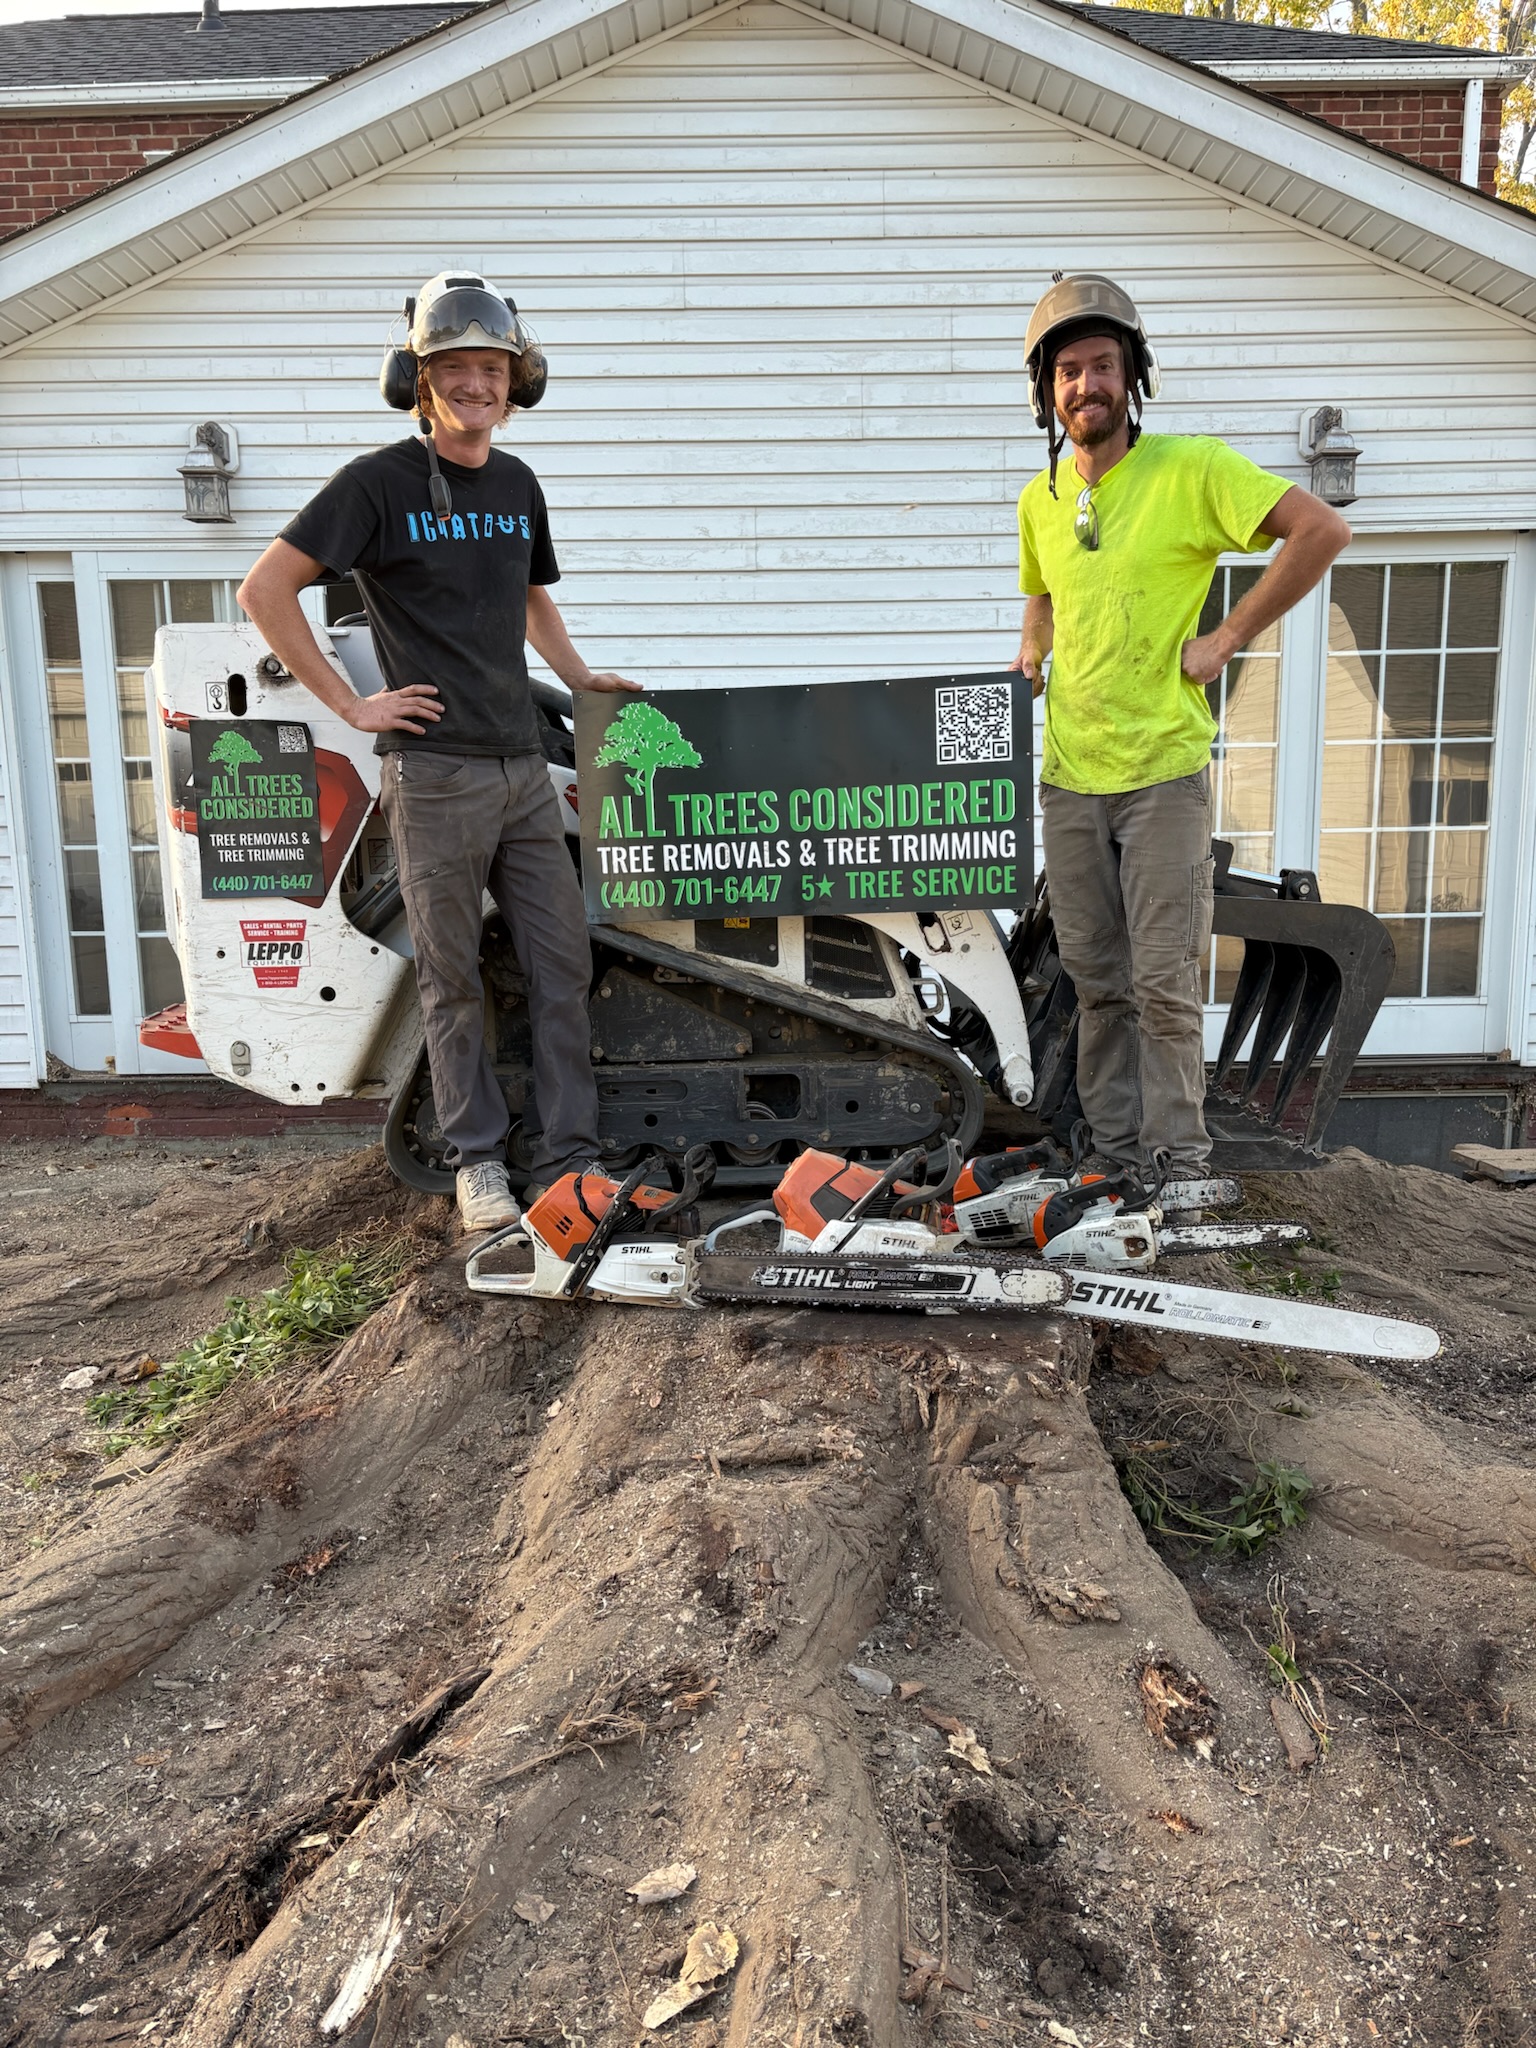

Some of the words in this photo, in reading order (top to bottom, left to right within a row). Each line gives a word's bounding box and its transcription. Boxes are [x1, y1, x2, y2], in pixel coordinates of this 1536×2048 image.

[211, 775, 245, 797] ALL
[245, 774, 303, 796] TREES
[200, 796, 314, 821] CONSIDERED
[599, 796, 667, 839] ALL
[668, 790, 780, 837] TREES
[789, 778, 1016, 833] CONSIDERED
[209, 833, 236, 847] TREE
[240, 832, 299, 846] REMOVALS
[301, 831, 311, 845] &
[218, 849, 245, 863] TREE
[247, 847, 305, 862] TRIMMING
[597, 845, 655, 875] TREE
[662, 839, 791, 872] REMOVALS
[799, 838, 817, 867] &
[823, 836, 882, 866] TREE
[888, 829, 1017, 863] TRIMMING
[212, 876, 249, 892] (440)
[251, 874, 313, 890] 701-6447
[600, 879, 666, 909] (440)
[671, 874, 782, 906] 701-6447
[845, 870, 904, 899] TREE
[912, 865, 1018, 897] SERVICE
[243, 922, 259, 930] SALES
[247, 942, 303, 961] LEPPO
[1012, 1192, 1041, 1202] STIHL
[881, 1236, 920, 1250] STIHL
[1085, 1229, 1116, 1239] STIHL
[621, 1246, 653, 1254] STIHL
[760, 1267, 842, 1289] STIHL
[844, 1279, 879, 1290] LIGHT
[1072, 1281, 1166, 1315] STIHL
[1168, 1306, 1253, 1329] ROLLOMATIC
[1252, 1319, 1272, 1331] ES
